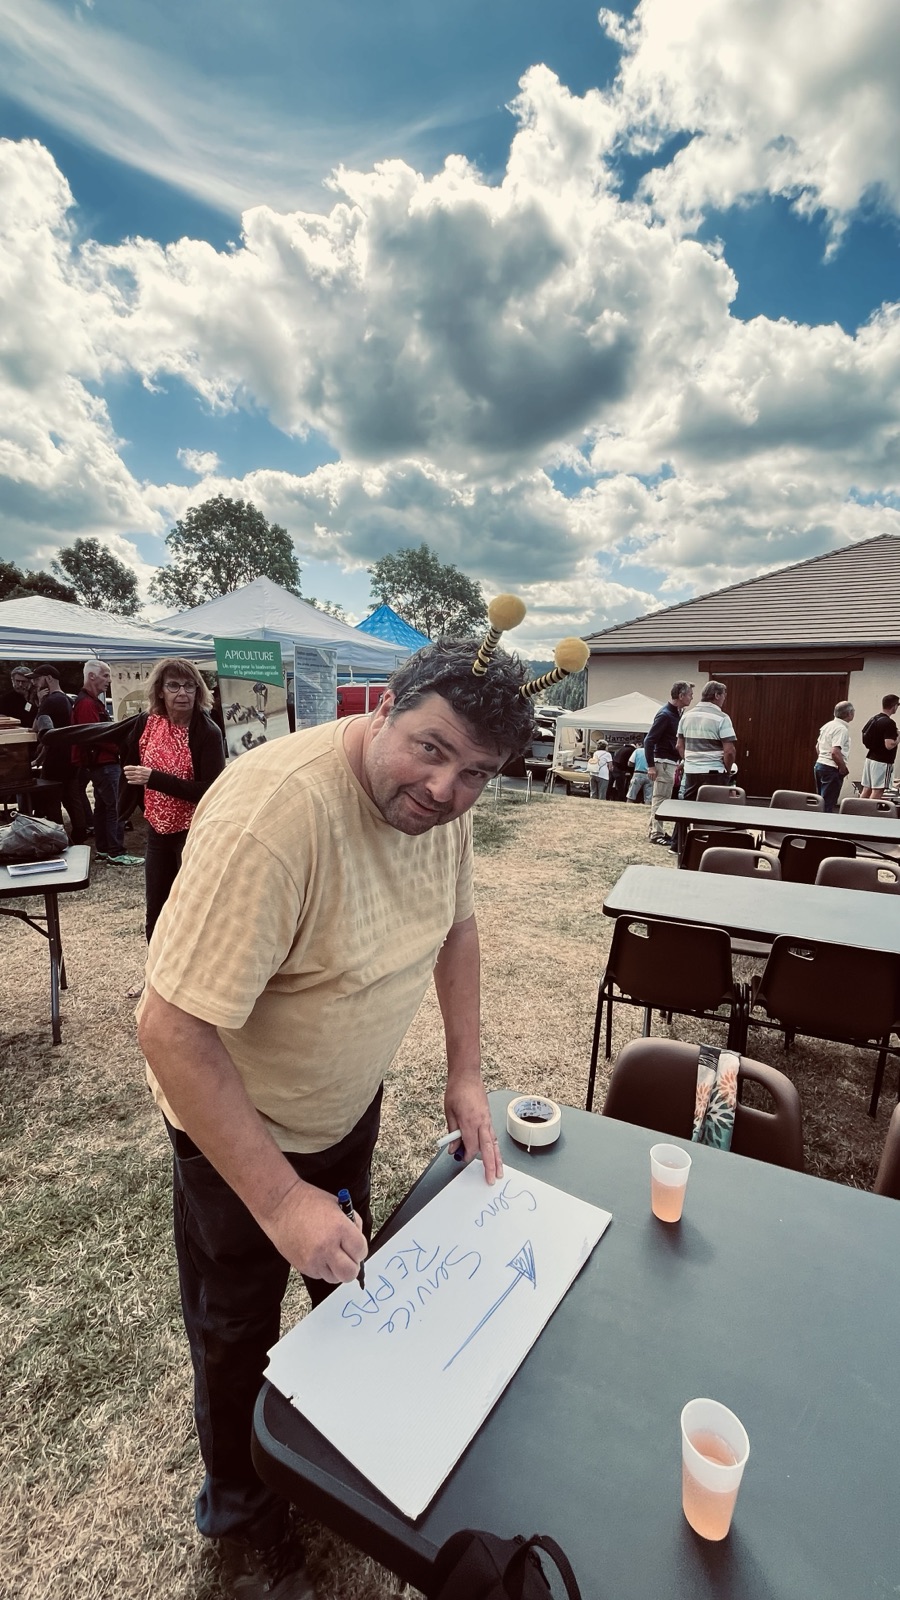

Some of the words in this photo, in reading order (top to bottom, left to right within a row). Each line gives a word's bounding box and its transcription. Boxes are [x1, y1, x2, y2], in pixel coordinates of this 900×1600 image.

[224, 650, 274, 661] APICULTURE
[474, 1178, 537, 1228] Sens
[341, 1239, 440, 1328] REPAS
[377, 1244, 482, 1333] Service
